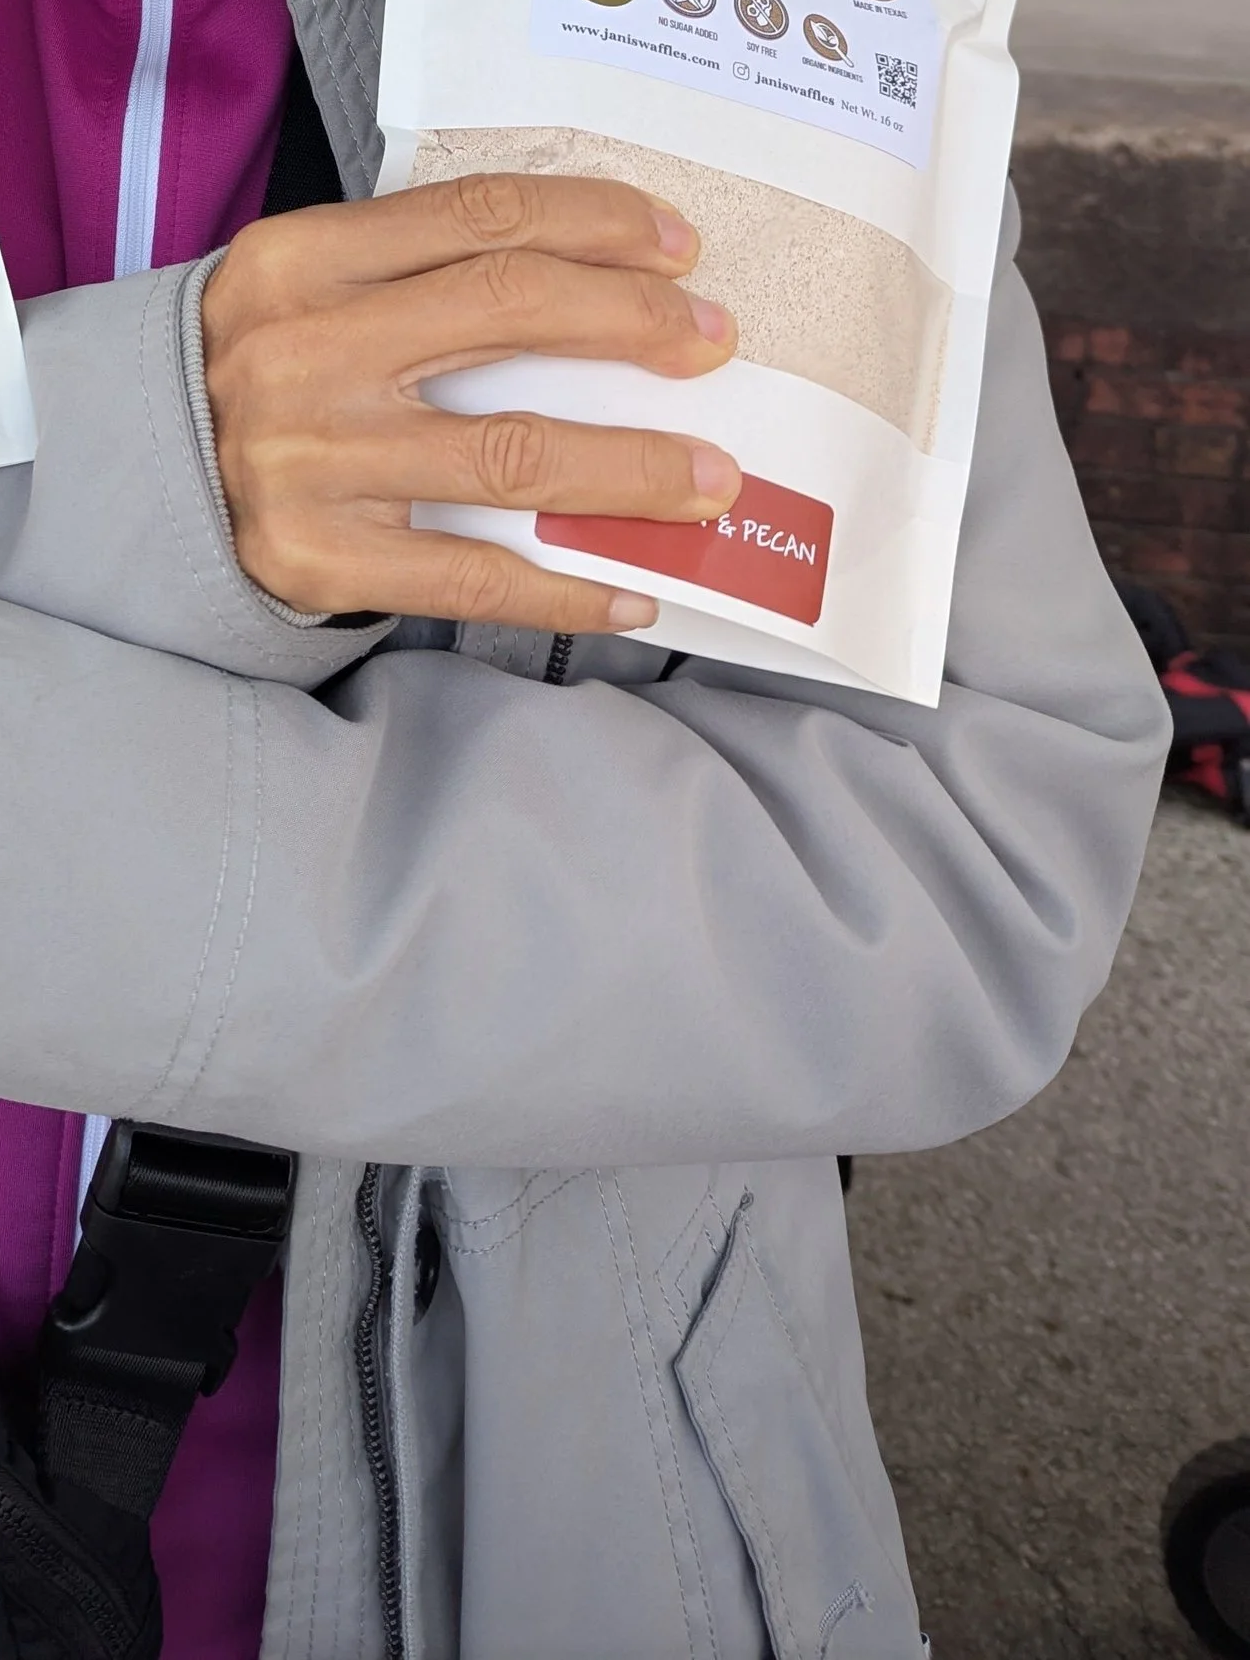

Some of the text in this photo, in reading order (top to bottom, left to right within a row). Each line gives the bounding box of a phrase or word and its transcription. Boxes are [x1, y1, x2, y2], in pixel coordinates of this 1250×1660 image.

[853, 0, 908, 19] MADE IN TEXAS
[658, 16, 718, 41] NO SUGAR ADDED
[746, 42, 778, 59] SOY FREE
[802, 56, 827, 71] ORGANIC
[562, 22, 904, 133] www.janiswaffles.com janiswaffles Net Wt. 16 oz
[718, 513, 816, 566] & PECAN
